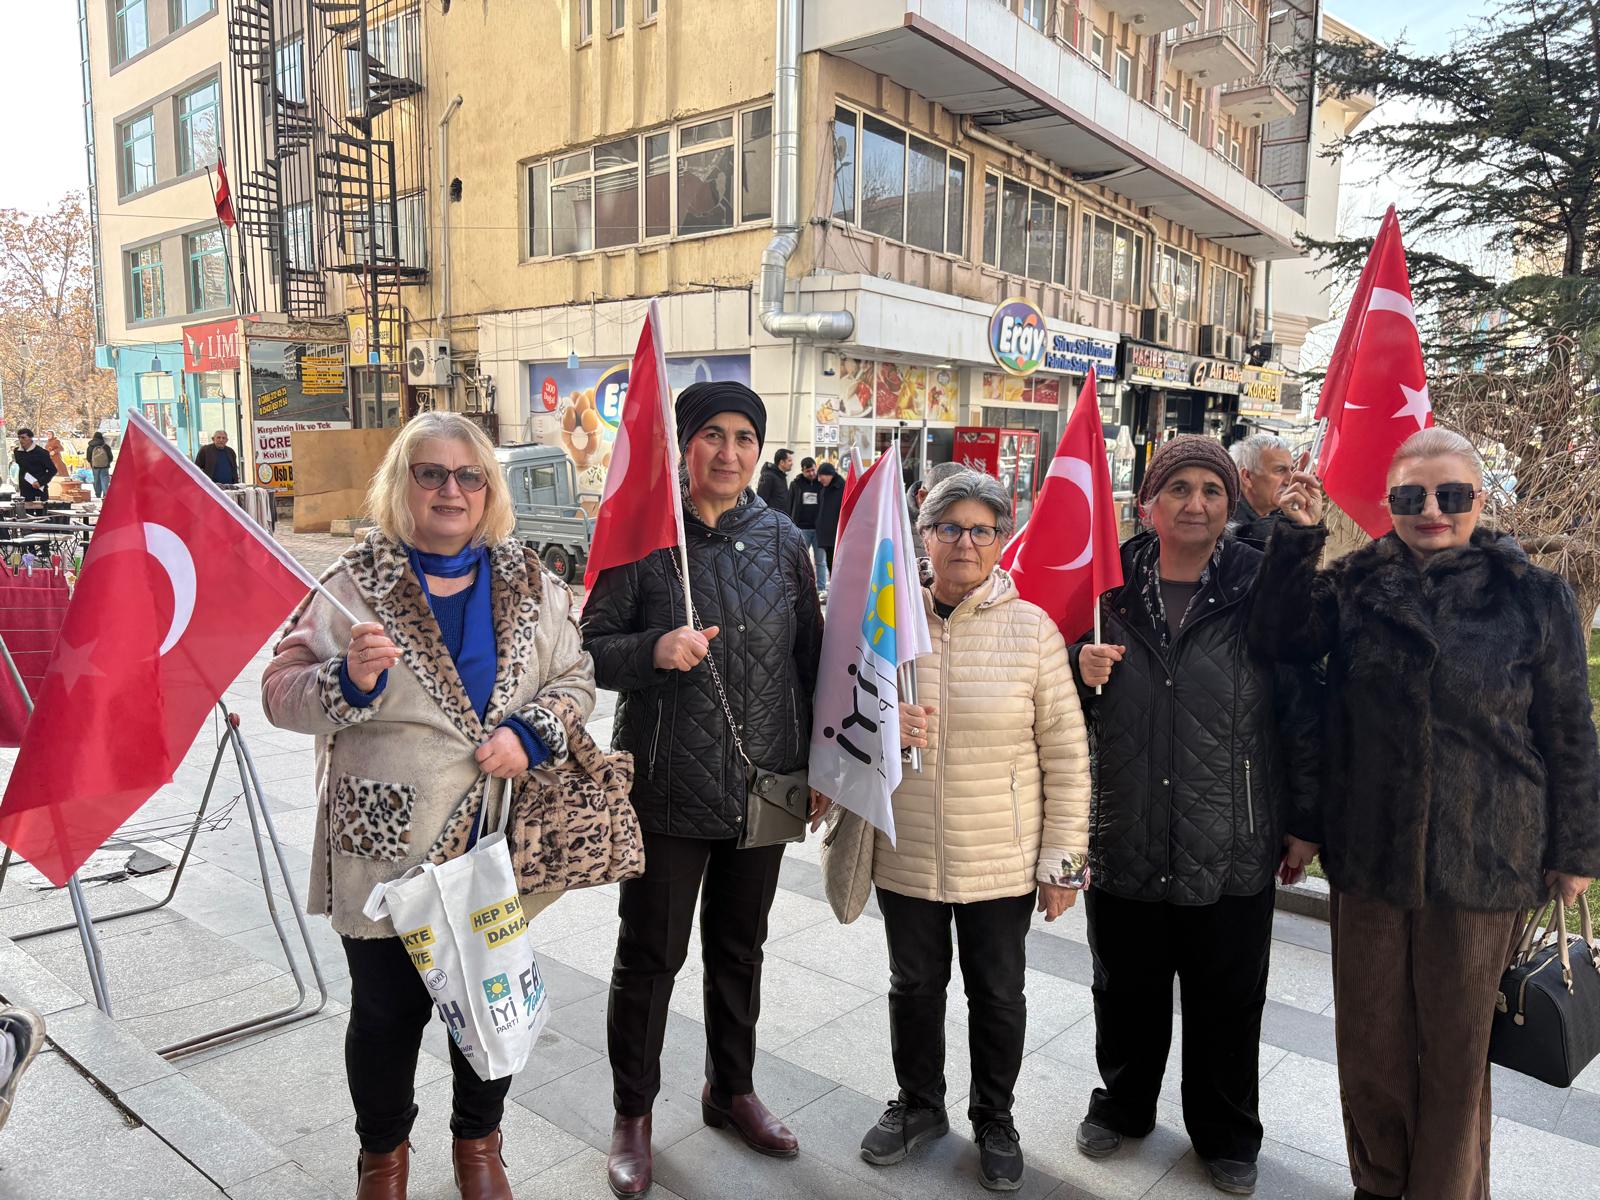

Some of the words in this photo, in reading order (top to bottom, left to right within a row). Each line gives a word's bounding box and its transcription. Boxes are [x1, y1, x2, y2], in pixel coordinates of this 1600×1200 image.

[1000, 316, 1045, 360] Eray
[263, 450, 288, 459] Koleji
[273, 465, 288, 481] Osb
[474, 909, 500, 928] HEP
[504, 896, 520, 915] Bİ
[487, 917, 526, 943] DAHA
[410, 952, 431, 965] İYE
[489, 996, 517, 1026] İYİ
[496, 1017, 519, 1035] PARTİ
